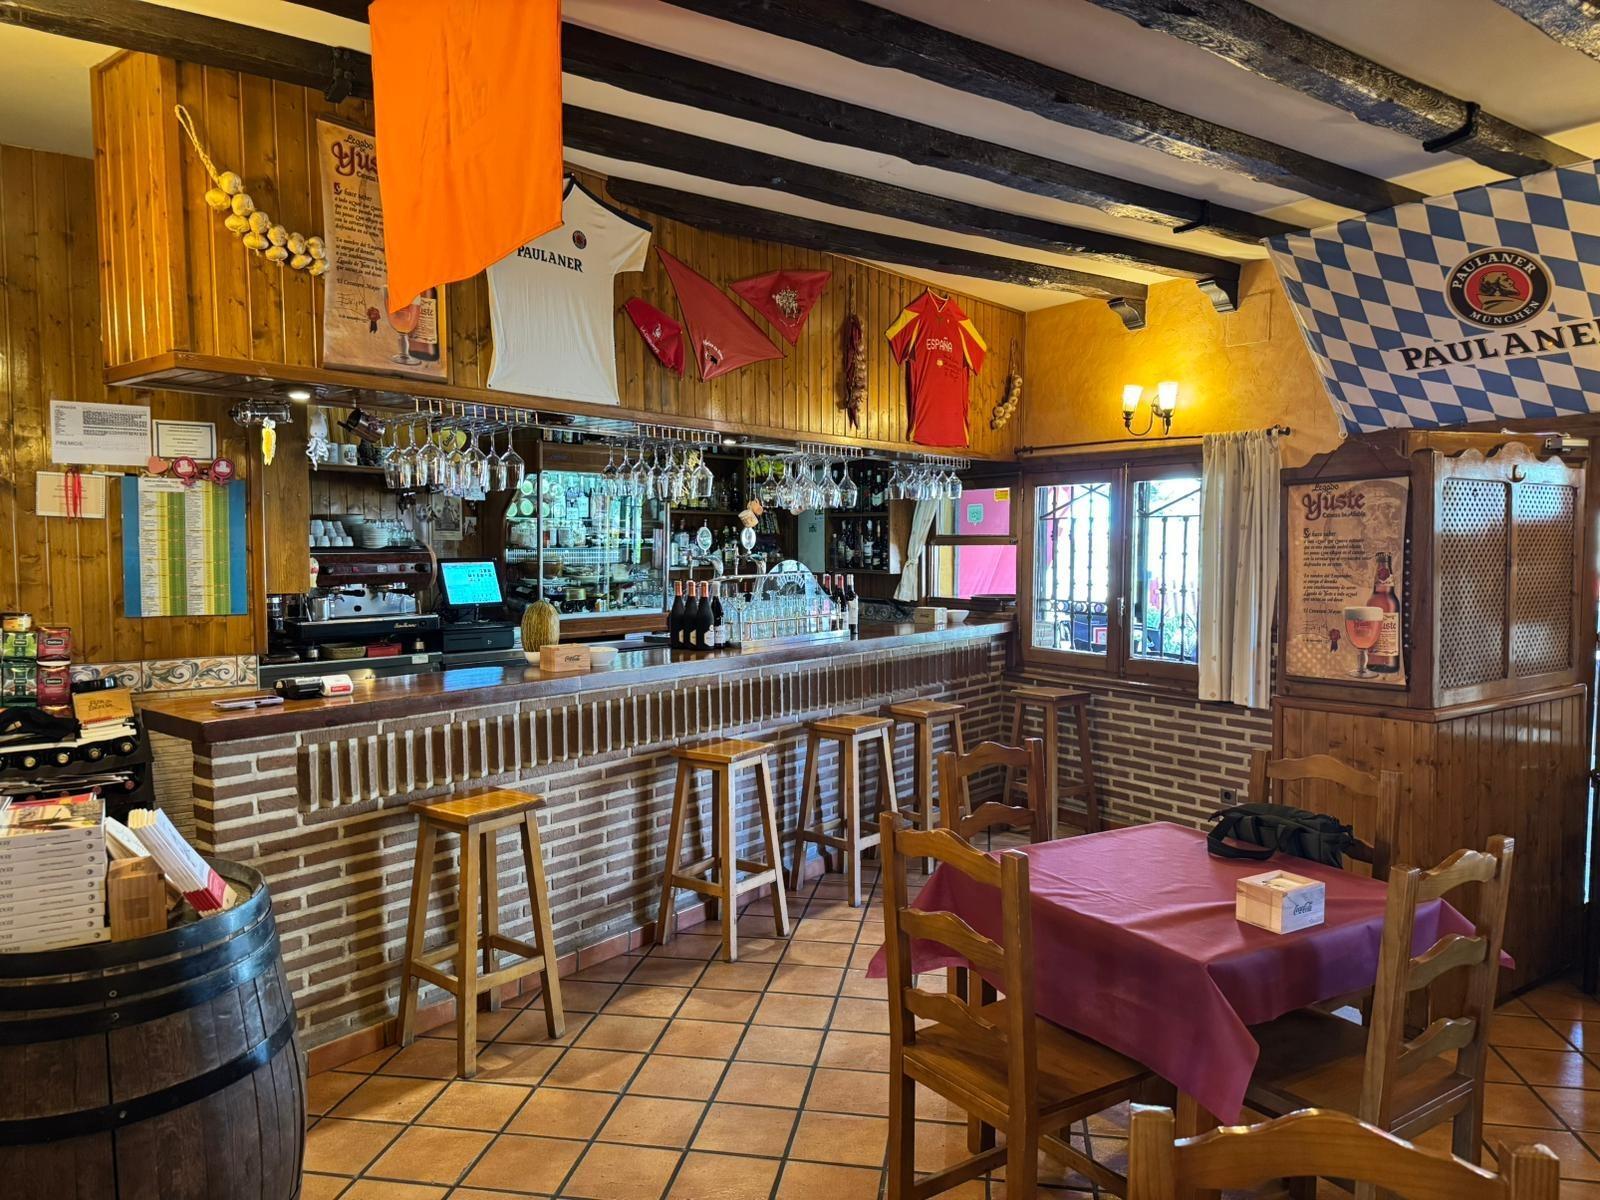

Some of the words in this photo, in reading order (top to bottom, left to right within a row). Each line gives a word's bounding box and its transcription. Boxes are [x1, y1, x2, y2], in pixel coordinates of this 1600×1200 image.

[331, 141, 377, 176] Yus
[517, 246, 584, 273] PAULANER
[1452, 252, 1537, 289] PAULANER
[926, 336, 953, 353] ESPAÑA
[1302, 490, 1366, 521] Yuste
